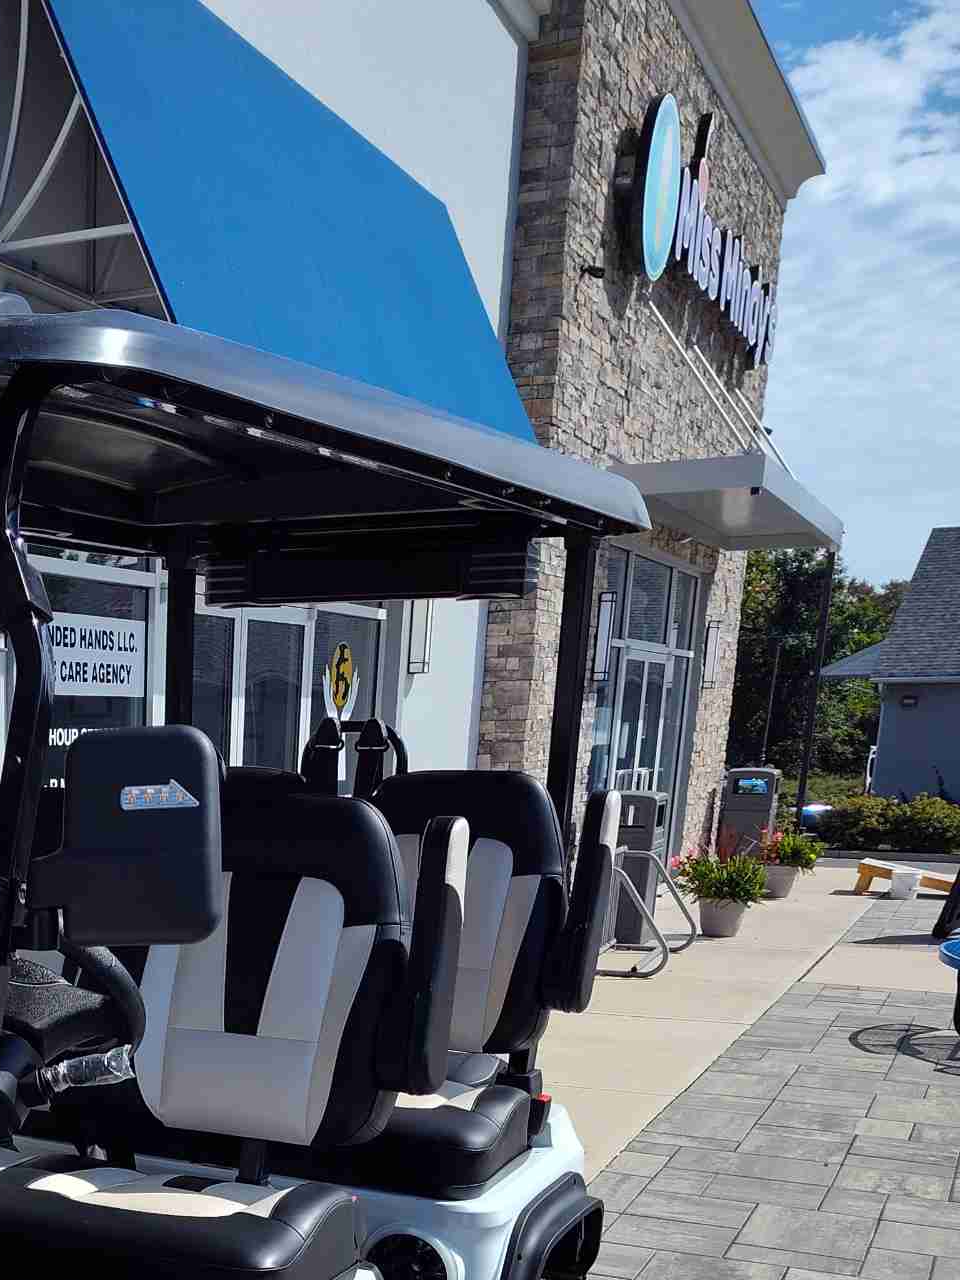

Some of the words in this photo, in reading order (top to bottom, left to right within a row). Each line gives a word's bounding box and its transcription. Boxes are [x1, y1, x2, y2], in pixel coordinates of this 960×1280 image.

[79, 627, 115, 651] HANDS
[117, 631, 138, 653] LLC.
[60, 660, 89, 683] CARE
[91, 662, 133, 685] AGENCY
